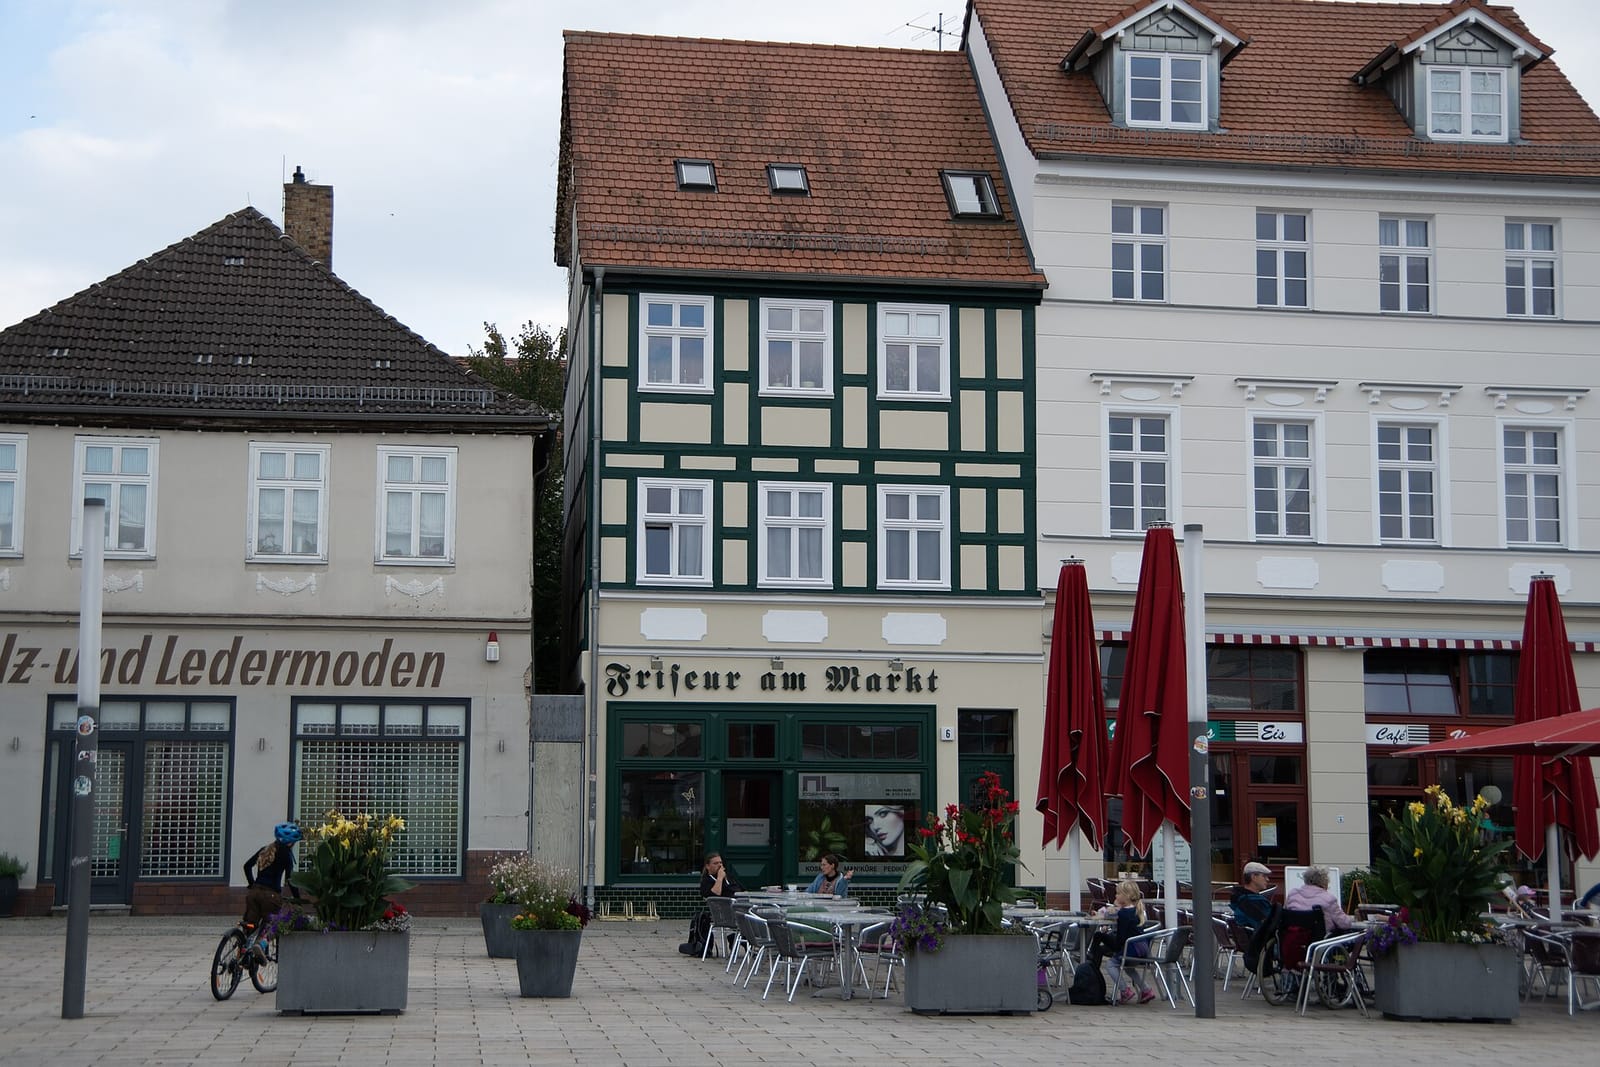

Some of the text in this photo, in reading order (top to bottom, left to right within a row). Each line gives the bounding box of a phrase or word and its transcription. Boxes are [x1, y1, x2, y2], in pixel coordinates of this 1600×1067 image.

[155, 635, 446, 688] Ledermoden
[760, 671, 807, 693] am
[825, 666, 939, 693] Markt
[945, 729, 951, 739] 6
[1261, 724, 1287, 741] Eis
[1375, 726, 1407, 745] Café
